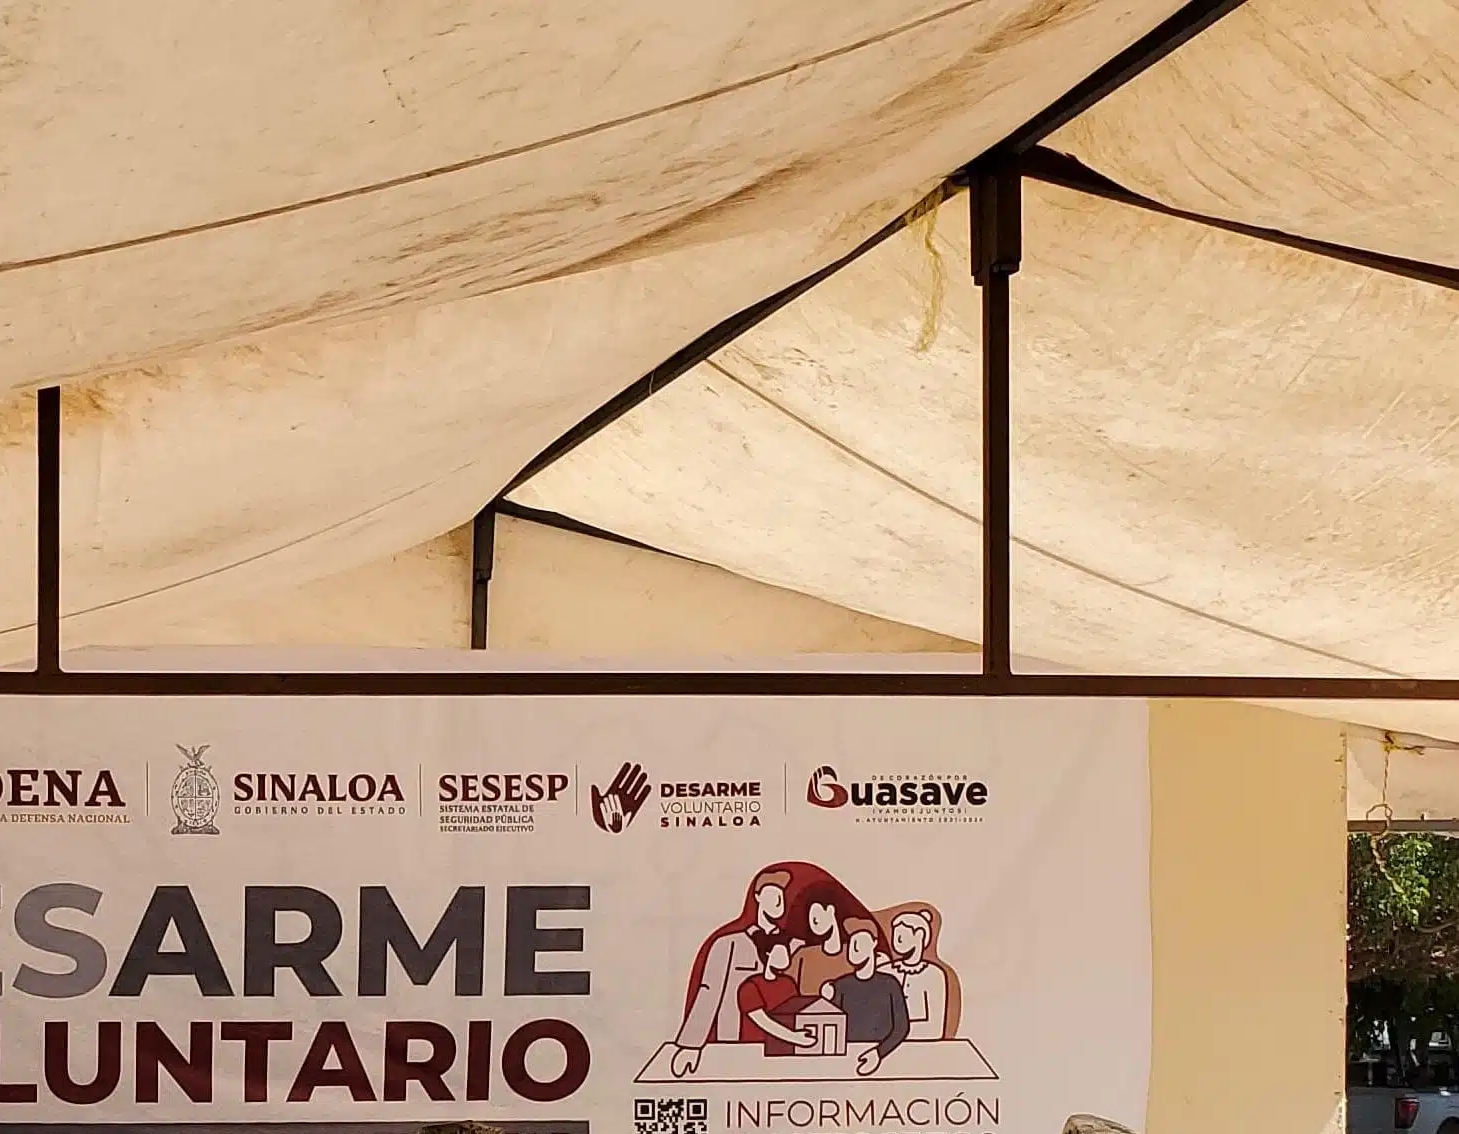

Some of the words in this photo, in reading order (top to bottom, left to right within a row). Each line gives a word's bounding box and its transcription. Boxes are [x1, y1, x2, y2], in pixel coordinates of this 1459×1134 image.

[233, 773, 405, 802] SINALOA
[438, 773, 569, 802] SESESP
[660, 782, 761, 798] DESARME
[234, 806, 309, 815] GOBIERNO
[317, 806, 343, 815] DEL
[351, 806, 406, 815] ESTADO
[439, 805, 480, 813] SISTEMA
[482, 805, 520, 813] ESTATAL
[522, 805, 535, 813] DE
[660, 801, 761, 813] VOLUNTARIO
[11, 813, 65, 824] DEFENSA
[68, 813, 130, 824] NACIONAL
[439, 815, 493, 824] SEGURIDAD
[494, 813, 534, 824] PÚBLICA
[660, 815, 761, 828] SINALOA
[495, 825, 534, 833] EJECUTIVO
[726, 1093, 1000, 1128] INFORMACIÓN
